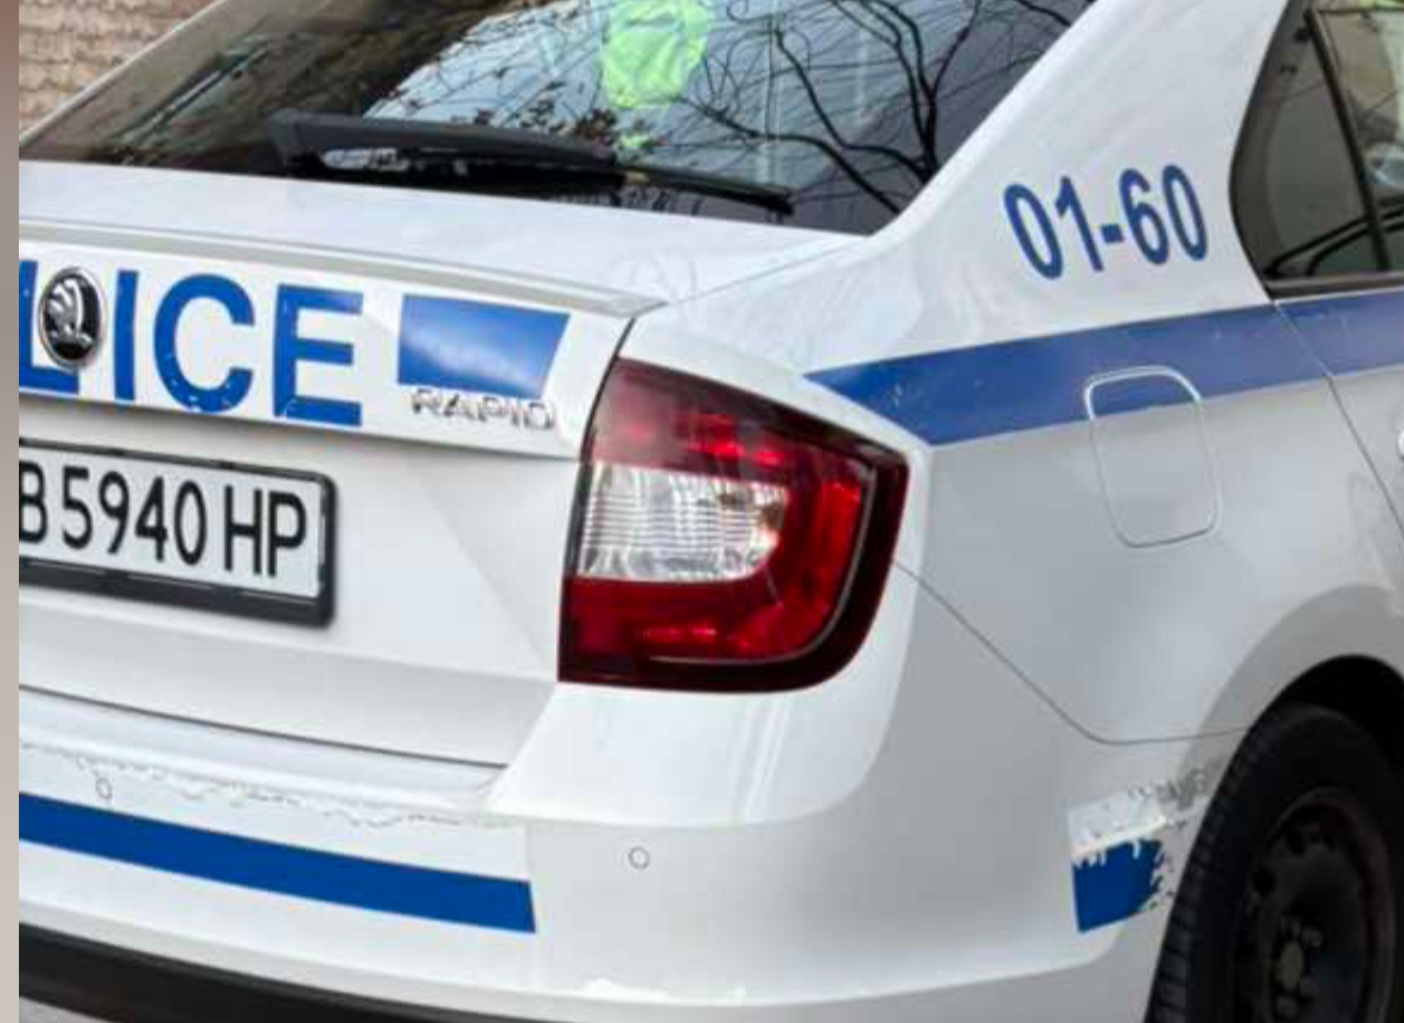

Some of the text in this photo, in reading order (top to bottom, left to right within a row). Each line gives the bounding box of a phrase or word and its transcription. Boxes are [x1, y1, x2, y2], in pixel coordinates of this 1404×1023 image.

[1003, 164, 1208, 280] 01-60
[19, 260, 364, 427] LICE
[411, 386, 556, 431] RAPID
[61, 466, 208, 567] 5940
[222, 484, 308, 577] HP
